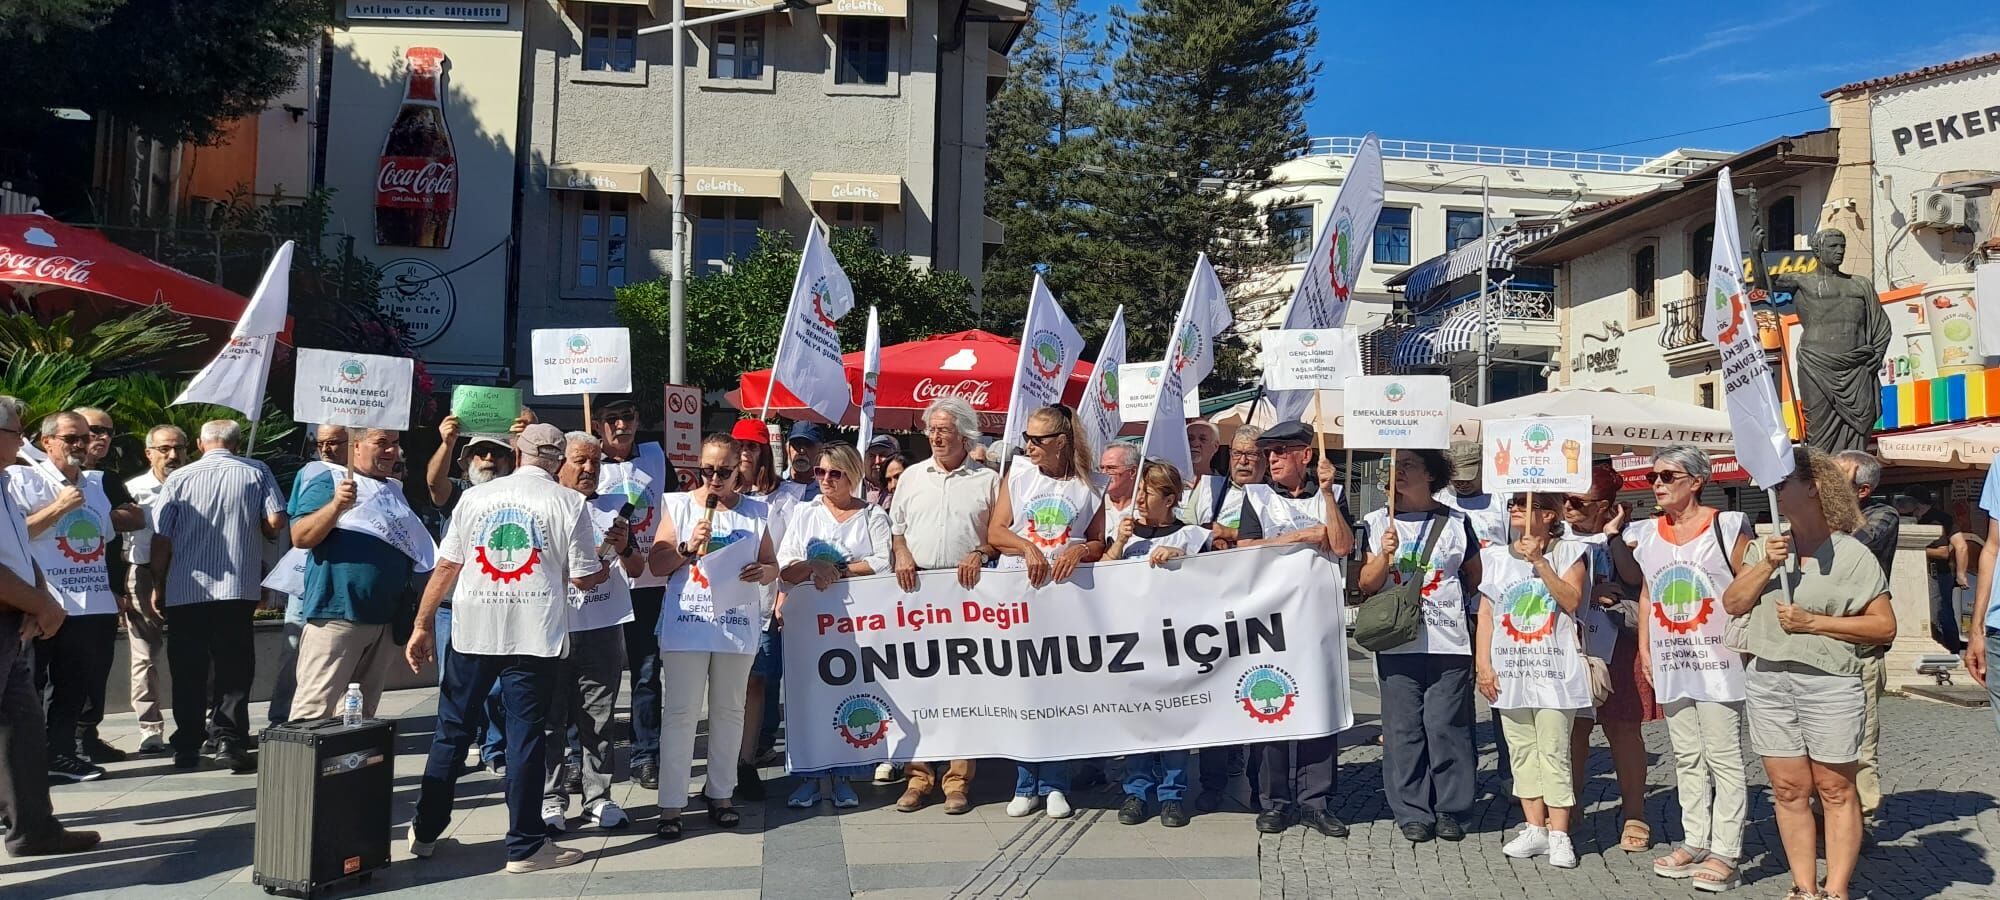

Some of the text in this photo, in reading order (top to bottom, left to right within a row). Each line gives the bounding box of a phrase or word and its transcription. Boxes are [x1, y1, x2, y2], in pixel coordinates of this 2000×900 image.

[353, 4, 400, 15] Artimo
[405, 6, 435, 16] Cafe
[1892, 105, 2000, 156] PEKER
[378, 161, 455, 194] Coca-Cola
[0, 246, 96, 284] oca-Cola
[377, 304, 440, 315] rtimo Cafe
[544, 356, 619, 366] SİZ DOYMADIĞINIZ
[572, 367, 588, 375] İÇİN
[319, 384, 389, 398] YILLARIN EMEĞİ
[913, 377, 992, 405] Coca-Cola
[320, 395, 385, 409] SADAKA DEĞİL
[1352, 409, 1443, 418] EMEKLİLER SUSTUKÇA
[1370, 418, 1419, 426] YOKSULLUK
[1378, 427, 1406, 436] BÜYÜR
[1592, 426, 1614, 437] LA
[1896, 443, 1942, 452] GELATERIA
[1971, 446, 1986, 454] LA
[1522, 466, 1545, 476] SÖZ
[1711, 460, 1739, 474] VİTAMİN
[47, 567, 67, 576] TÜM
[678, 593, 695, 601] TÜM
[817, 601, 1030, 636] Para İçin Değil
[818, 610, 1287, 687] ONURUMUZ İÇİN
[1495, 647, 1508, 656] TÜM
[1661, 650, 1708, 661] SENDİKASI
[1505, 658, 1551, 668] SENDİKASI
[1692, 660, 1730, 671] ŞUBESİ
[1496, 670, 1566, 680] ANTALYA ŞUBESİ
[911, 690, 1212, 722] TÜM EMEKLİLERİN SENDİKASI ANTALYA ŞUBEESİ
